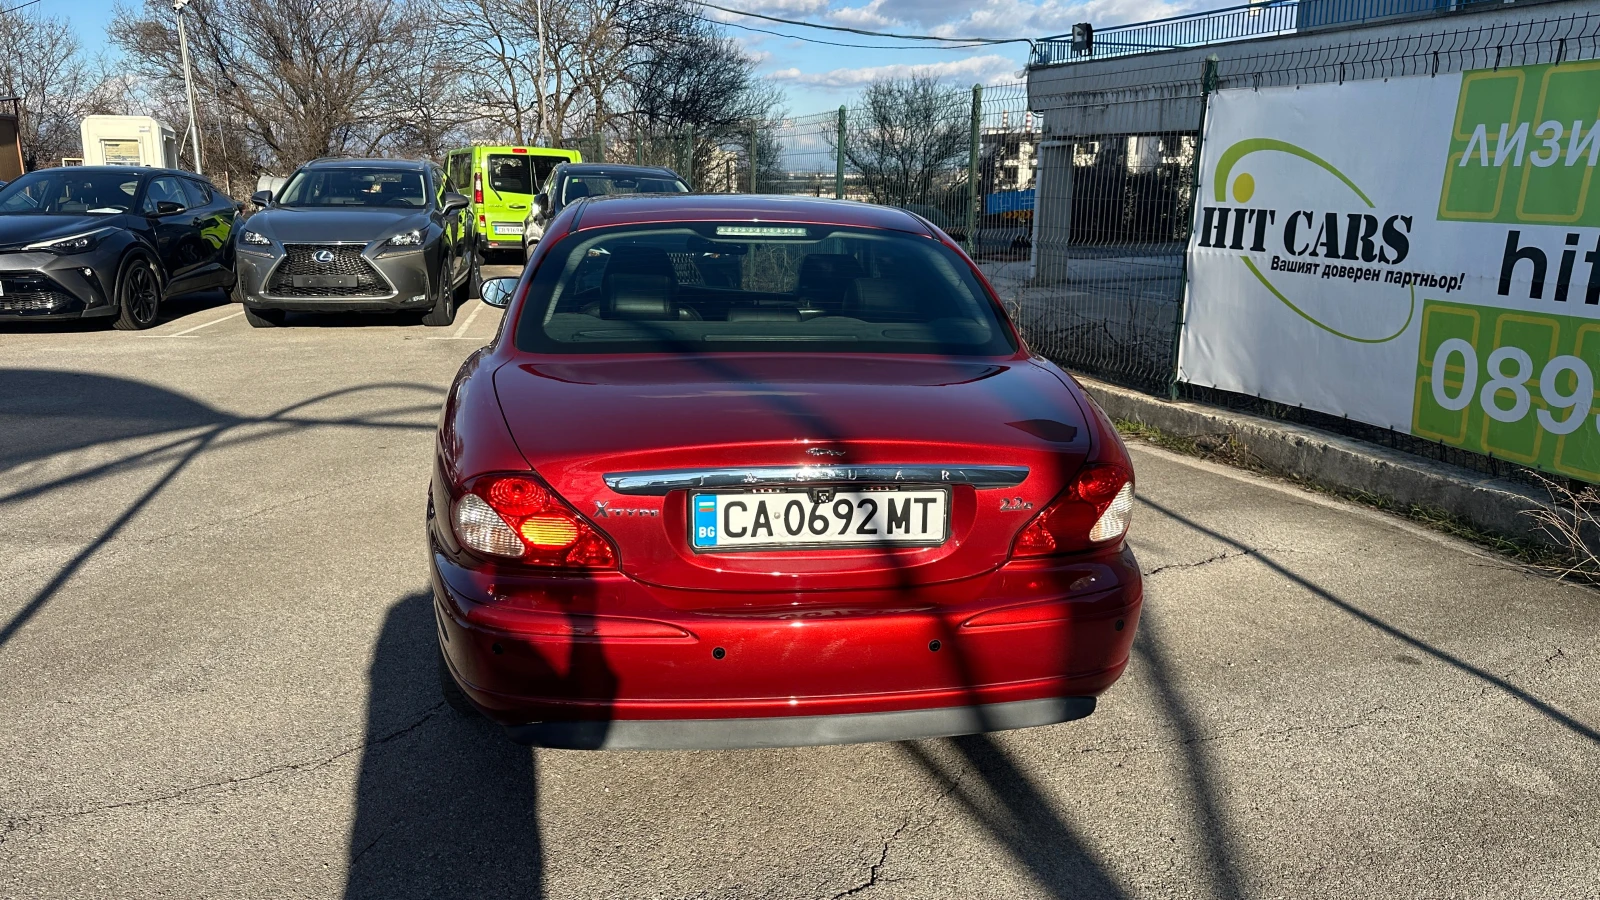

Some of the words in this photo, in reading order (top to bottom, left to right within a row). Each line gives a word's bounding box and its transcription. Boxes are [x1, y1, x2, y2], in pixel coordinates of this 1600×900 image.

[1197, 206, 1276, 254] HIT
[1283, 209, 1414, 266] CARS
[1270, 255, 1321, 276] Вашият
[1321, 263, 1382, 283] доверен
[1384, 268, 1466, 294] партньор!
[1431, 337, 1600, 436] 089
[698, 526, 716, 539] BG
[723, 499, 774, 539] CA
[783, 498, 879, 537] 0692
[886, 497, 938, 535] MT
